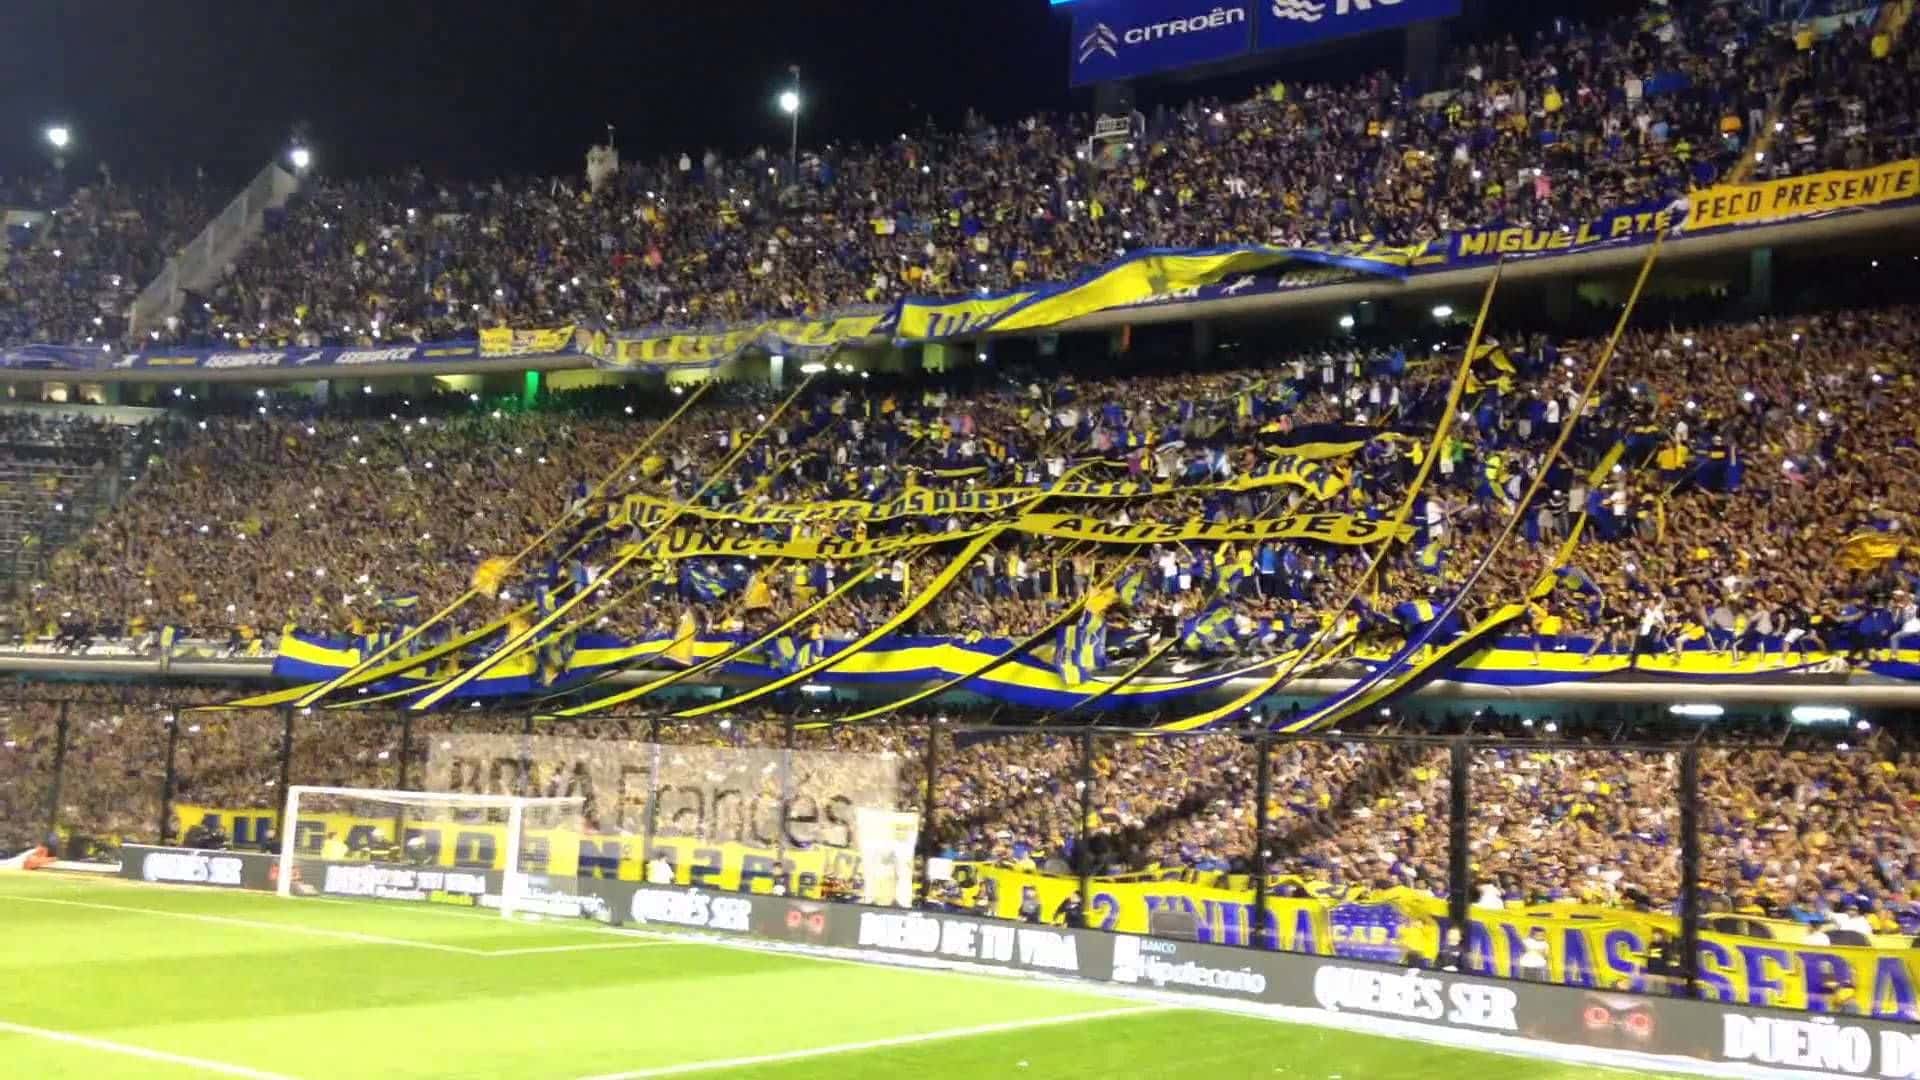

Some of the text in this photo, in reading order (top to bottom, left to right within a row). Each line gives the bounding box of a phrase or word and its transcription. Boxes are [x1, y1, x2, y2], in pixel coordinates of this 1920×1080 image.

[1695, 169, 1913, 221] FECO PRESENTE
[1459, 223, 1601, 256] MIGUEL
[1052, 515, 1378, 538] AMISTADES
[941, 919, 978, 957] DE
[979, 924, 1015, 961] TU
[1017, 929, 1079, 970] VIDA
[1314, 966, 1519, 1029] QUERÉS SER
[1723, 1013, 1920, 1078] DUEÑO D
